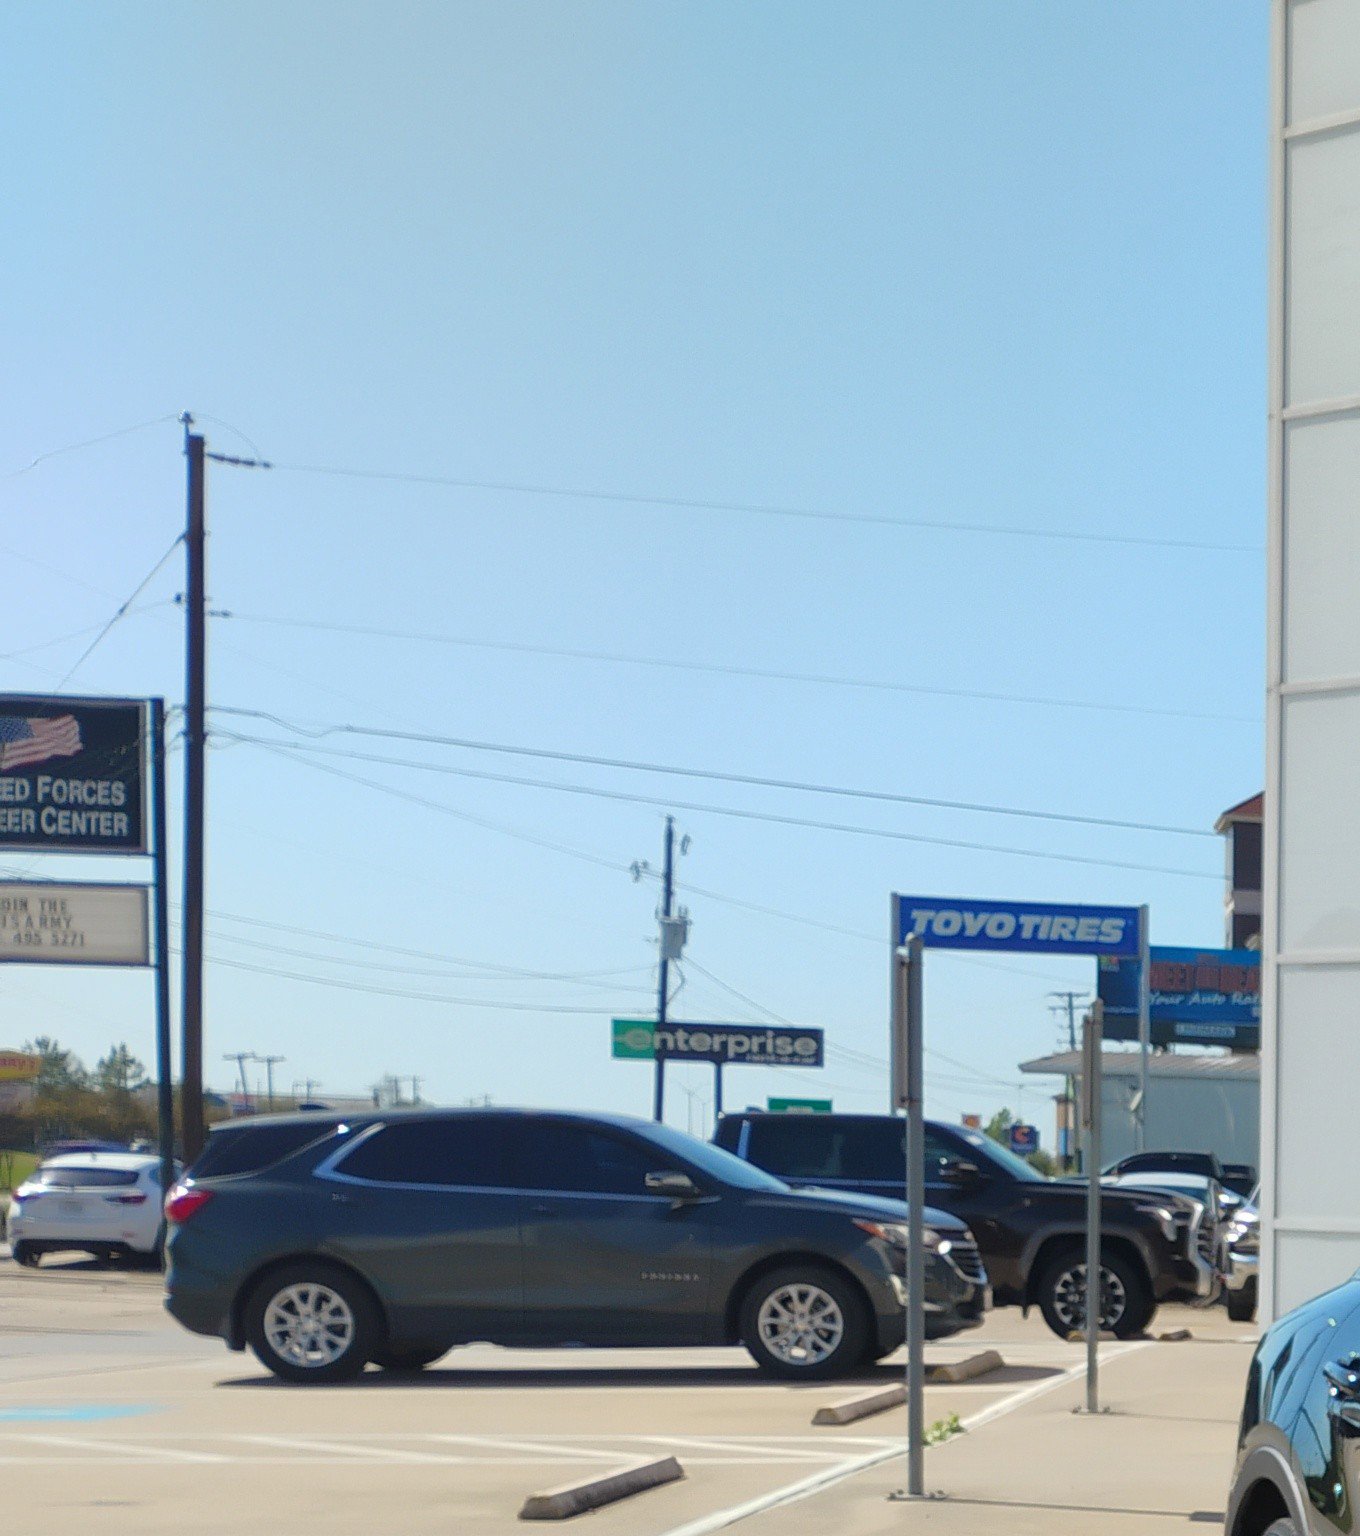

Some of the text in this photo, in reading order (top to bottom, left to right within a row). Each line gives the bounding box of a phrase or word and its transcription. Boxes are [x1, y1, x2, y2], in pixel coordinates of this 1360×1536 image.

[37, 775, 125, 806] FORCES
[41, 805, 128, 836] CENTER
[910, 909, 1126, 944] TOYO TIRES
[618, 1029, 818, 1058] enterprise
